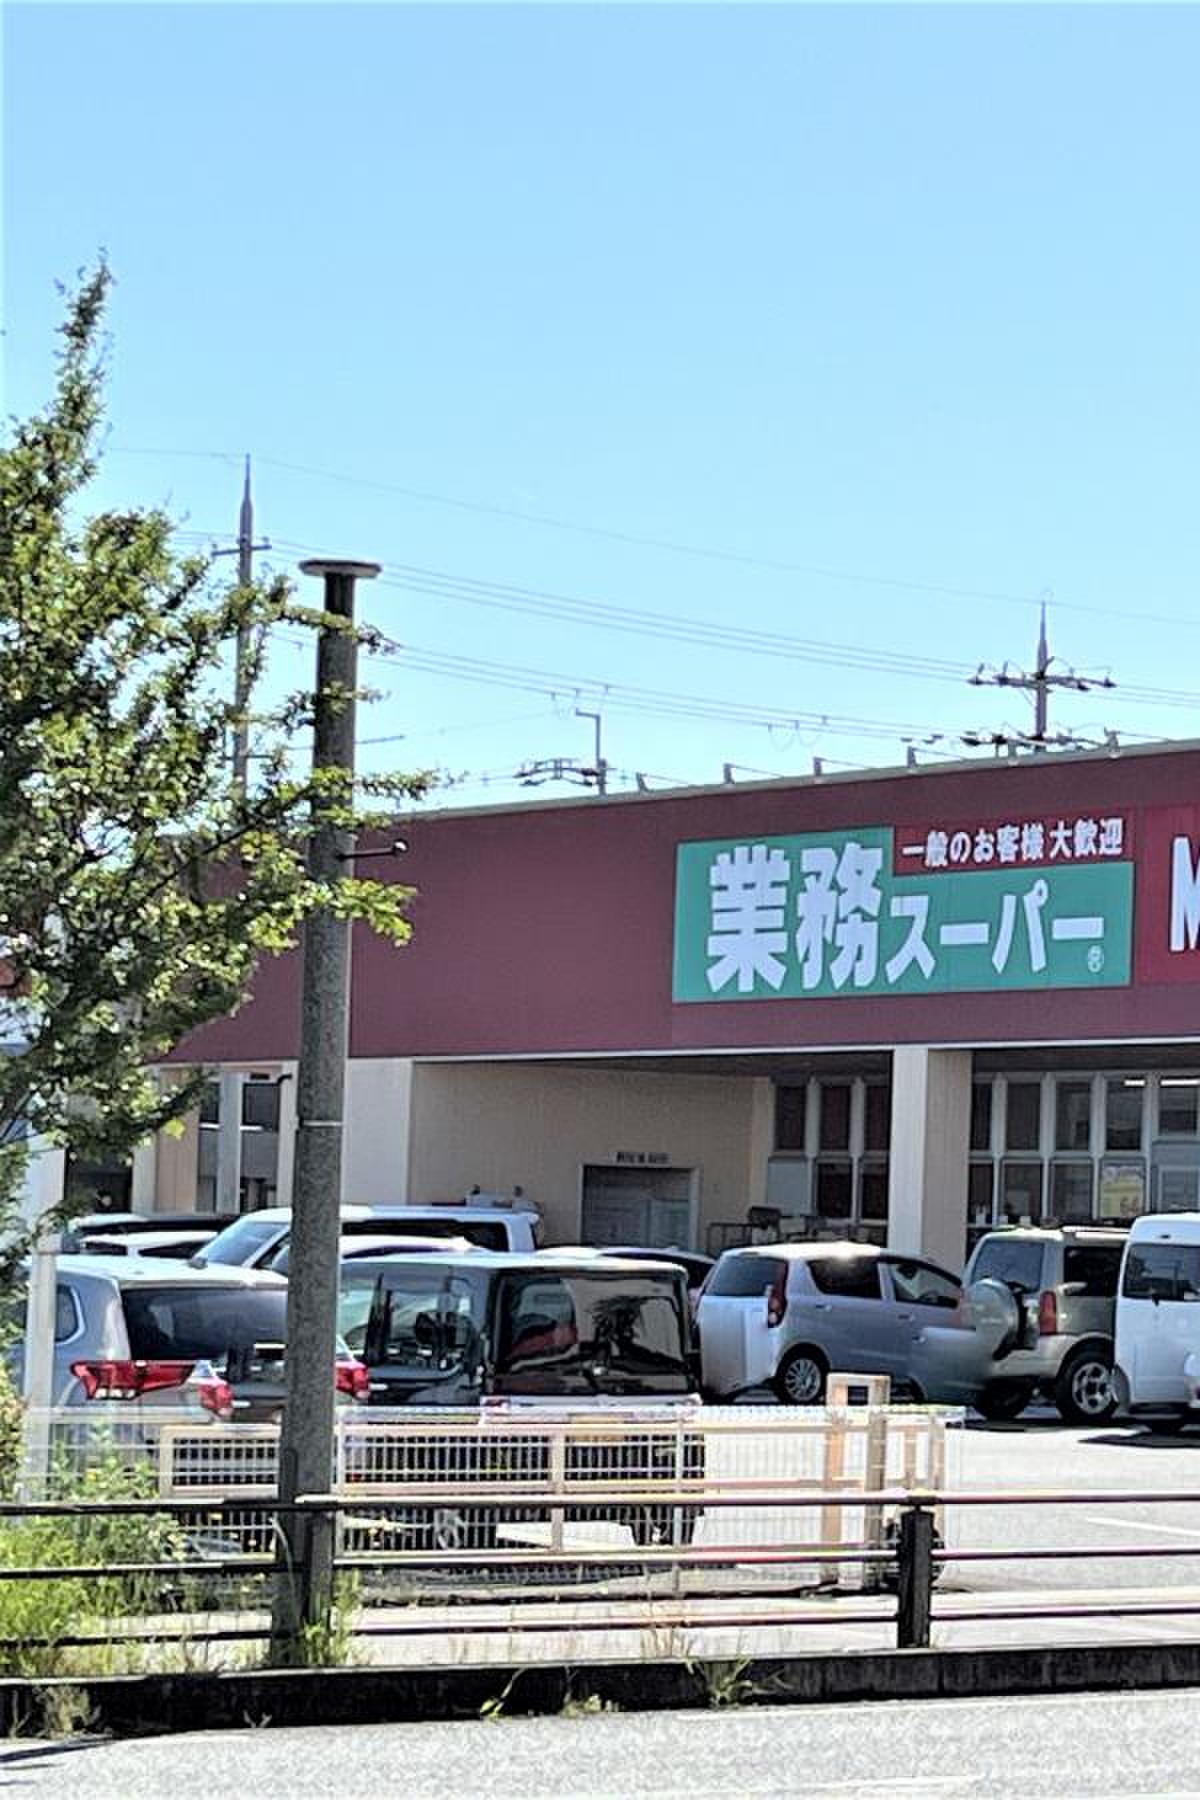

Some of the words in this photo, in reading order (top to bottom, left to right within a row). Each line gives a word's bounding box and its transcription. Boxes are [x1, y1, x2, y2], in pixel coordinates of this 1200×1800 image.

[705, 843, 1104, 993] 業務スーパー
